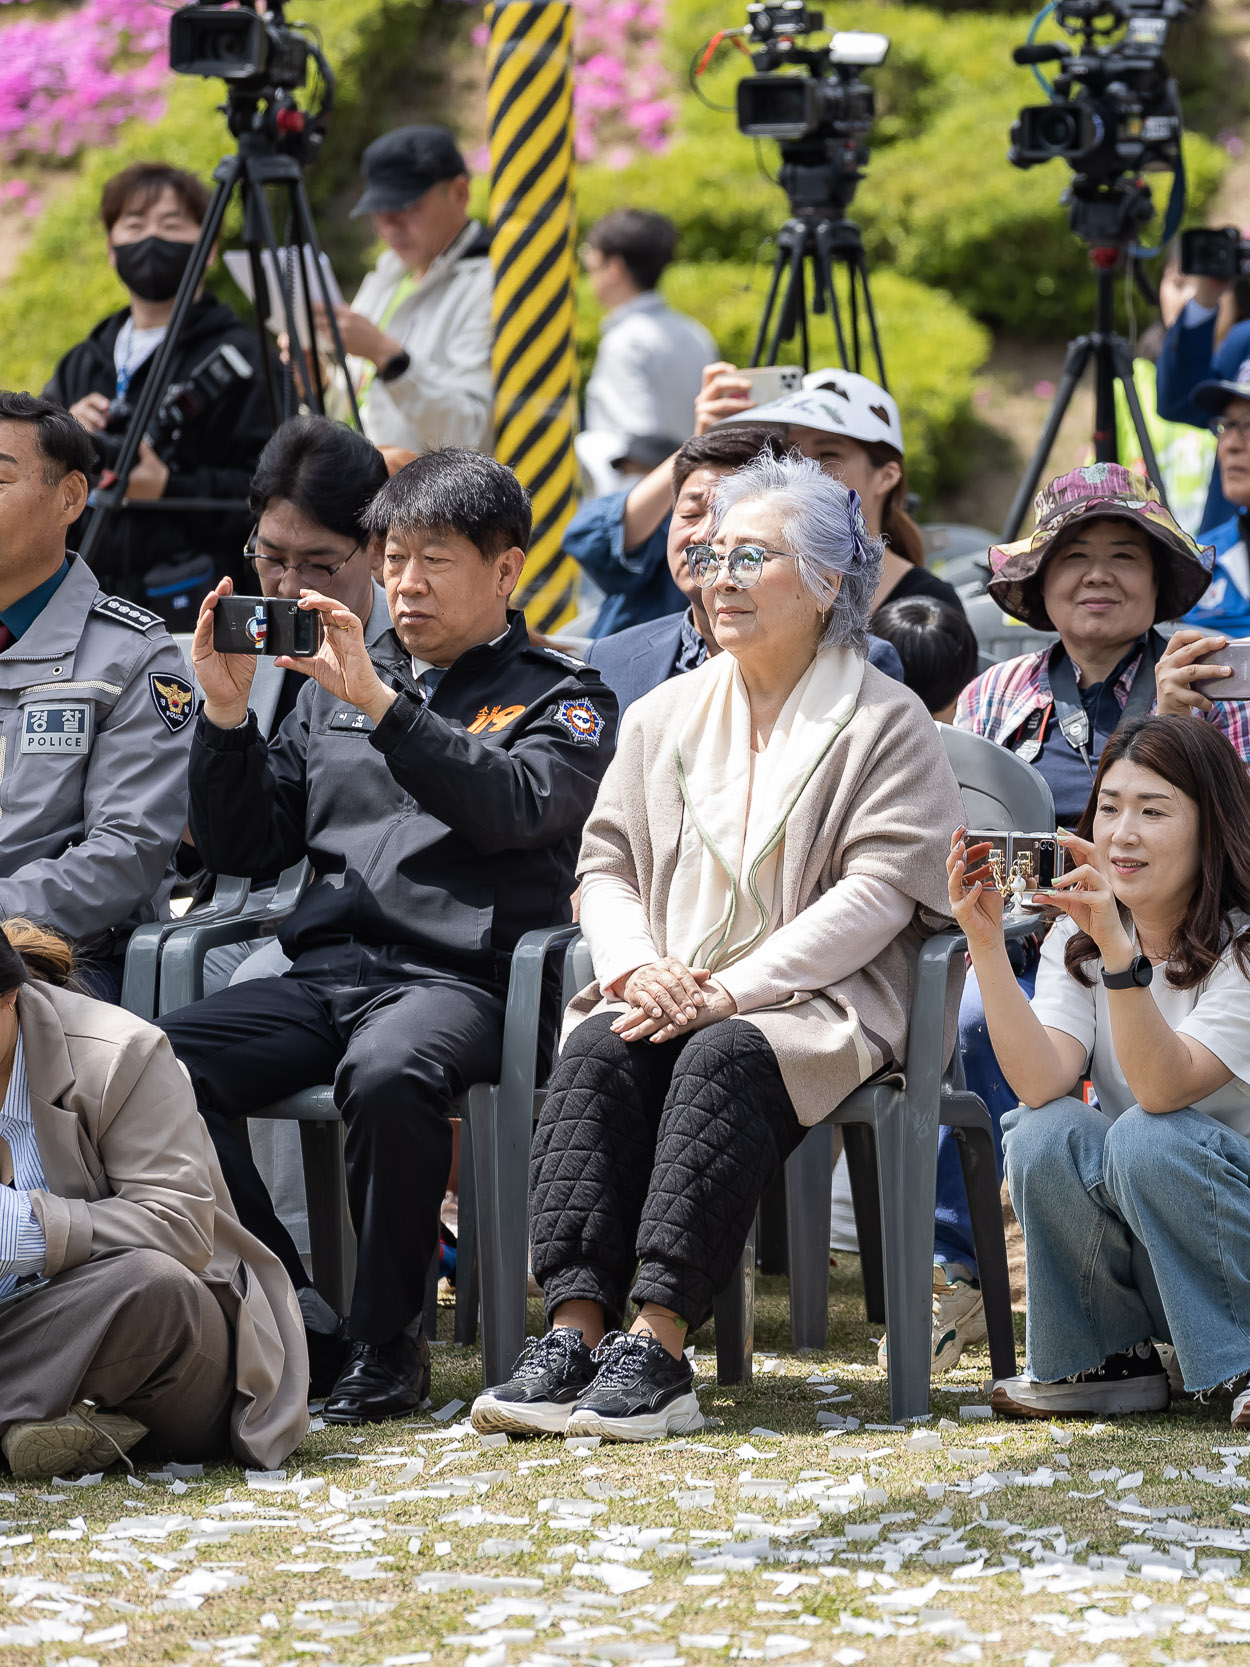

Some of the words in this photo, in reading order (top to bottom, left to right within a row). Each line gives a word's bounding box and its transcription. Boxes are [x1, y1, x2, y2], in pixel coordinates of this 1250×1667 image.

[166, 710, 184, 721] POLICE
[467, 704, 526, 735] 119
[28, 737, 82, 747] POLICE
